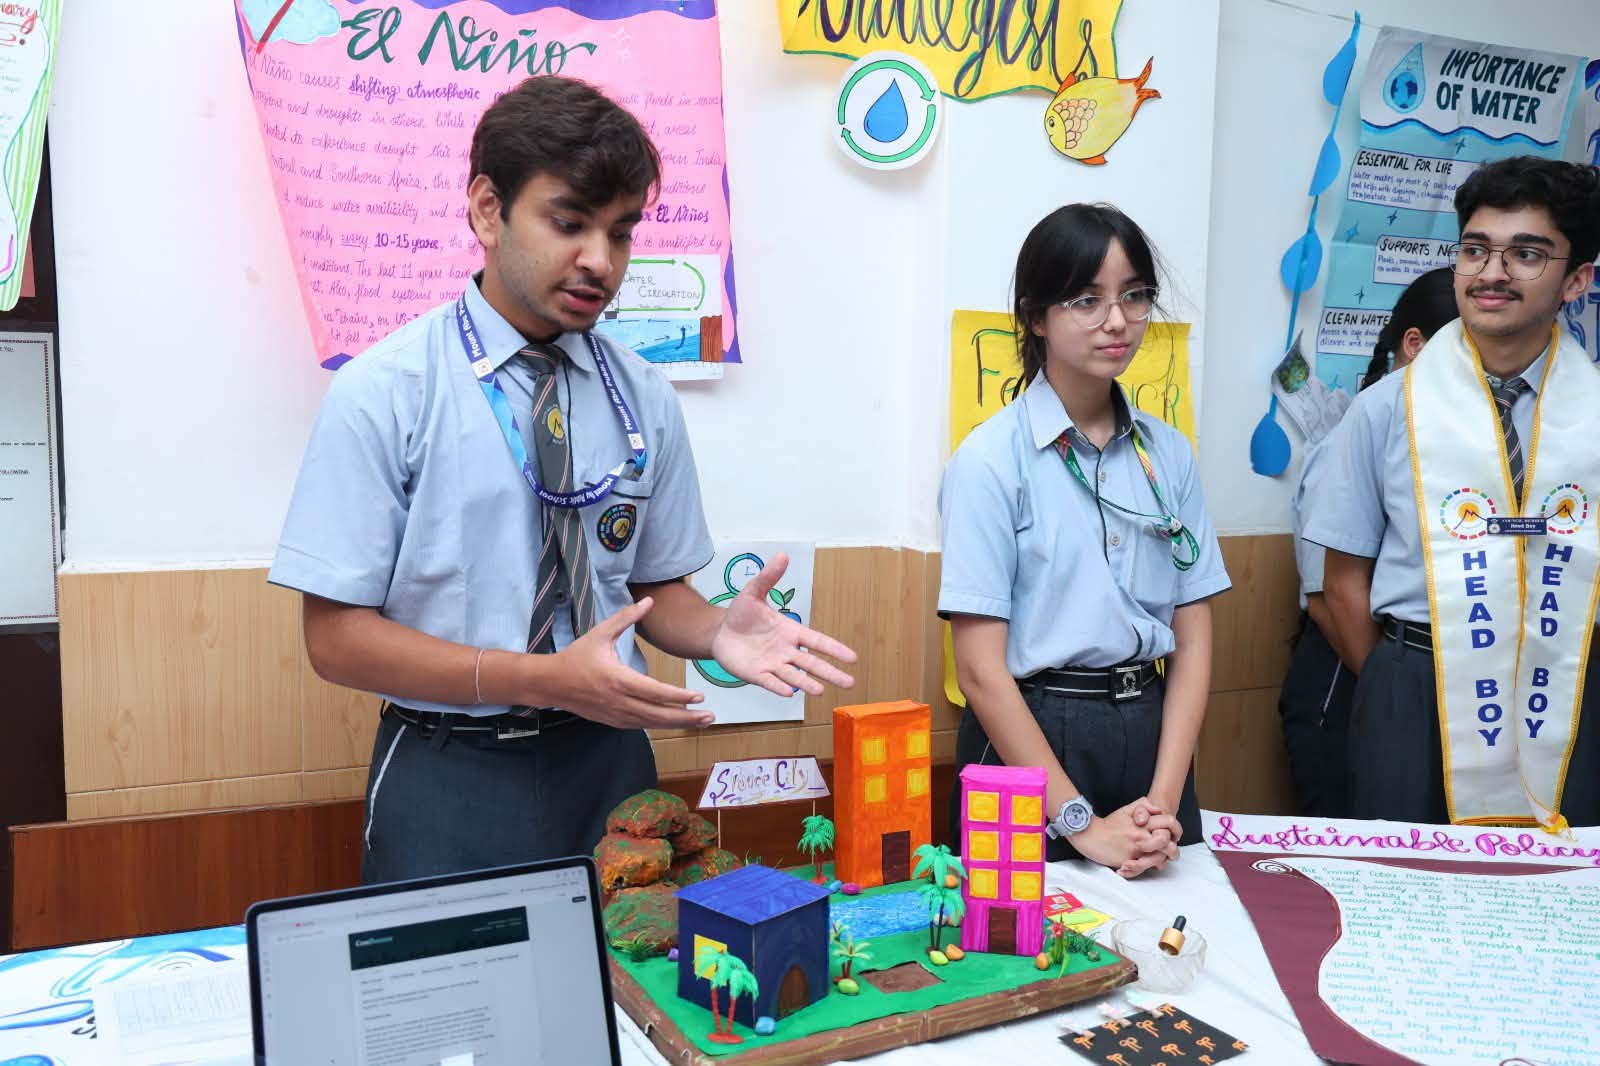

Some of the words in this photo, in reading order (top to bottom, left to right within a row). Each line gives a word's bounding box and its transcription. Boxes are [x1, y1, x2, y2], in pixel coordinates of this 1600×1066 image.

[341, 6, 401, 63] El
[418, 10, 597, 76] Niño
[348, 73, 400, 105] shifting
[406, 79, 481, 102] atmospheric
[1440, 48, 1566, 94] IMPORTANCE
[1436, 81, 1464, 111] OF
[1471, 87, 1541, 124] WATER
[1357, 150, 1409, 171] ESSENTIAL
[1414, 158, 1432, 173] FOR
[1435, 160, 1454, 175] LIFE
[1379, 238, 1431, 258] SUPPORTS
[638, 285, 701, 300] CIRCULATION
[1325, 311, 1358, 326] CLEAN
[1361, 313, 1391, 326] WATE
[1462, 550, 1496, 649] HEAD
[1540, 543, 1573, 638] HEAD
[1475, 678, 1503, 748] BOY
[1524, 667, 1550, 739] BOY
[1211, 816, 1470, 854] Sustainable
